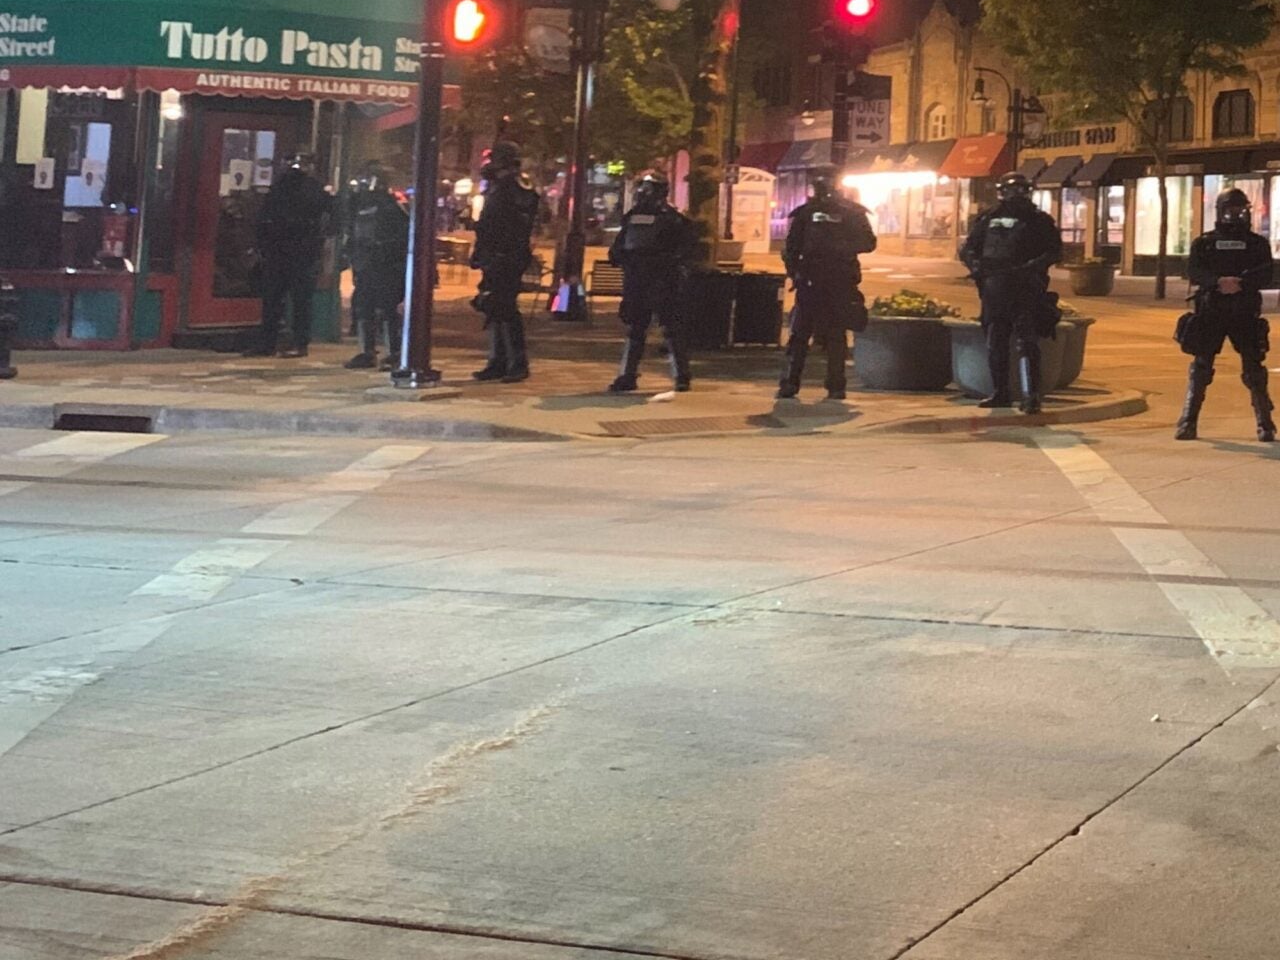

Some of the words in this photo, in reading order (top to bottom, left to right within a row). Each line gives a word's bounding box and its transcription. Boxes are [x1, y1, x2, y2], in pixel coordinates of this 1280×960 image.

[0, 12, 48, 33] State
[160, 21, 268, 64] Tutto
[281, 30, 383, 71] Pasta
[196, 73, 291, 91] AUTHENTIC
[298, 79, 361, 96] ITALIAN
[367, 83, 411, 98] FOOD
[857, 101, 886, 115] ONE
[856, 116, 885, 129] WAY
